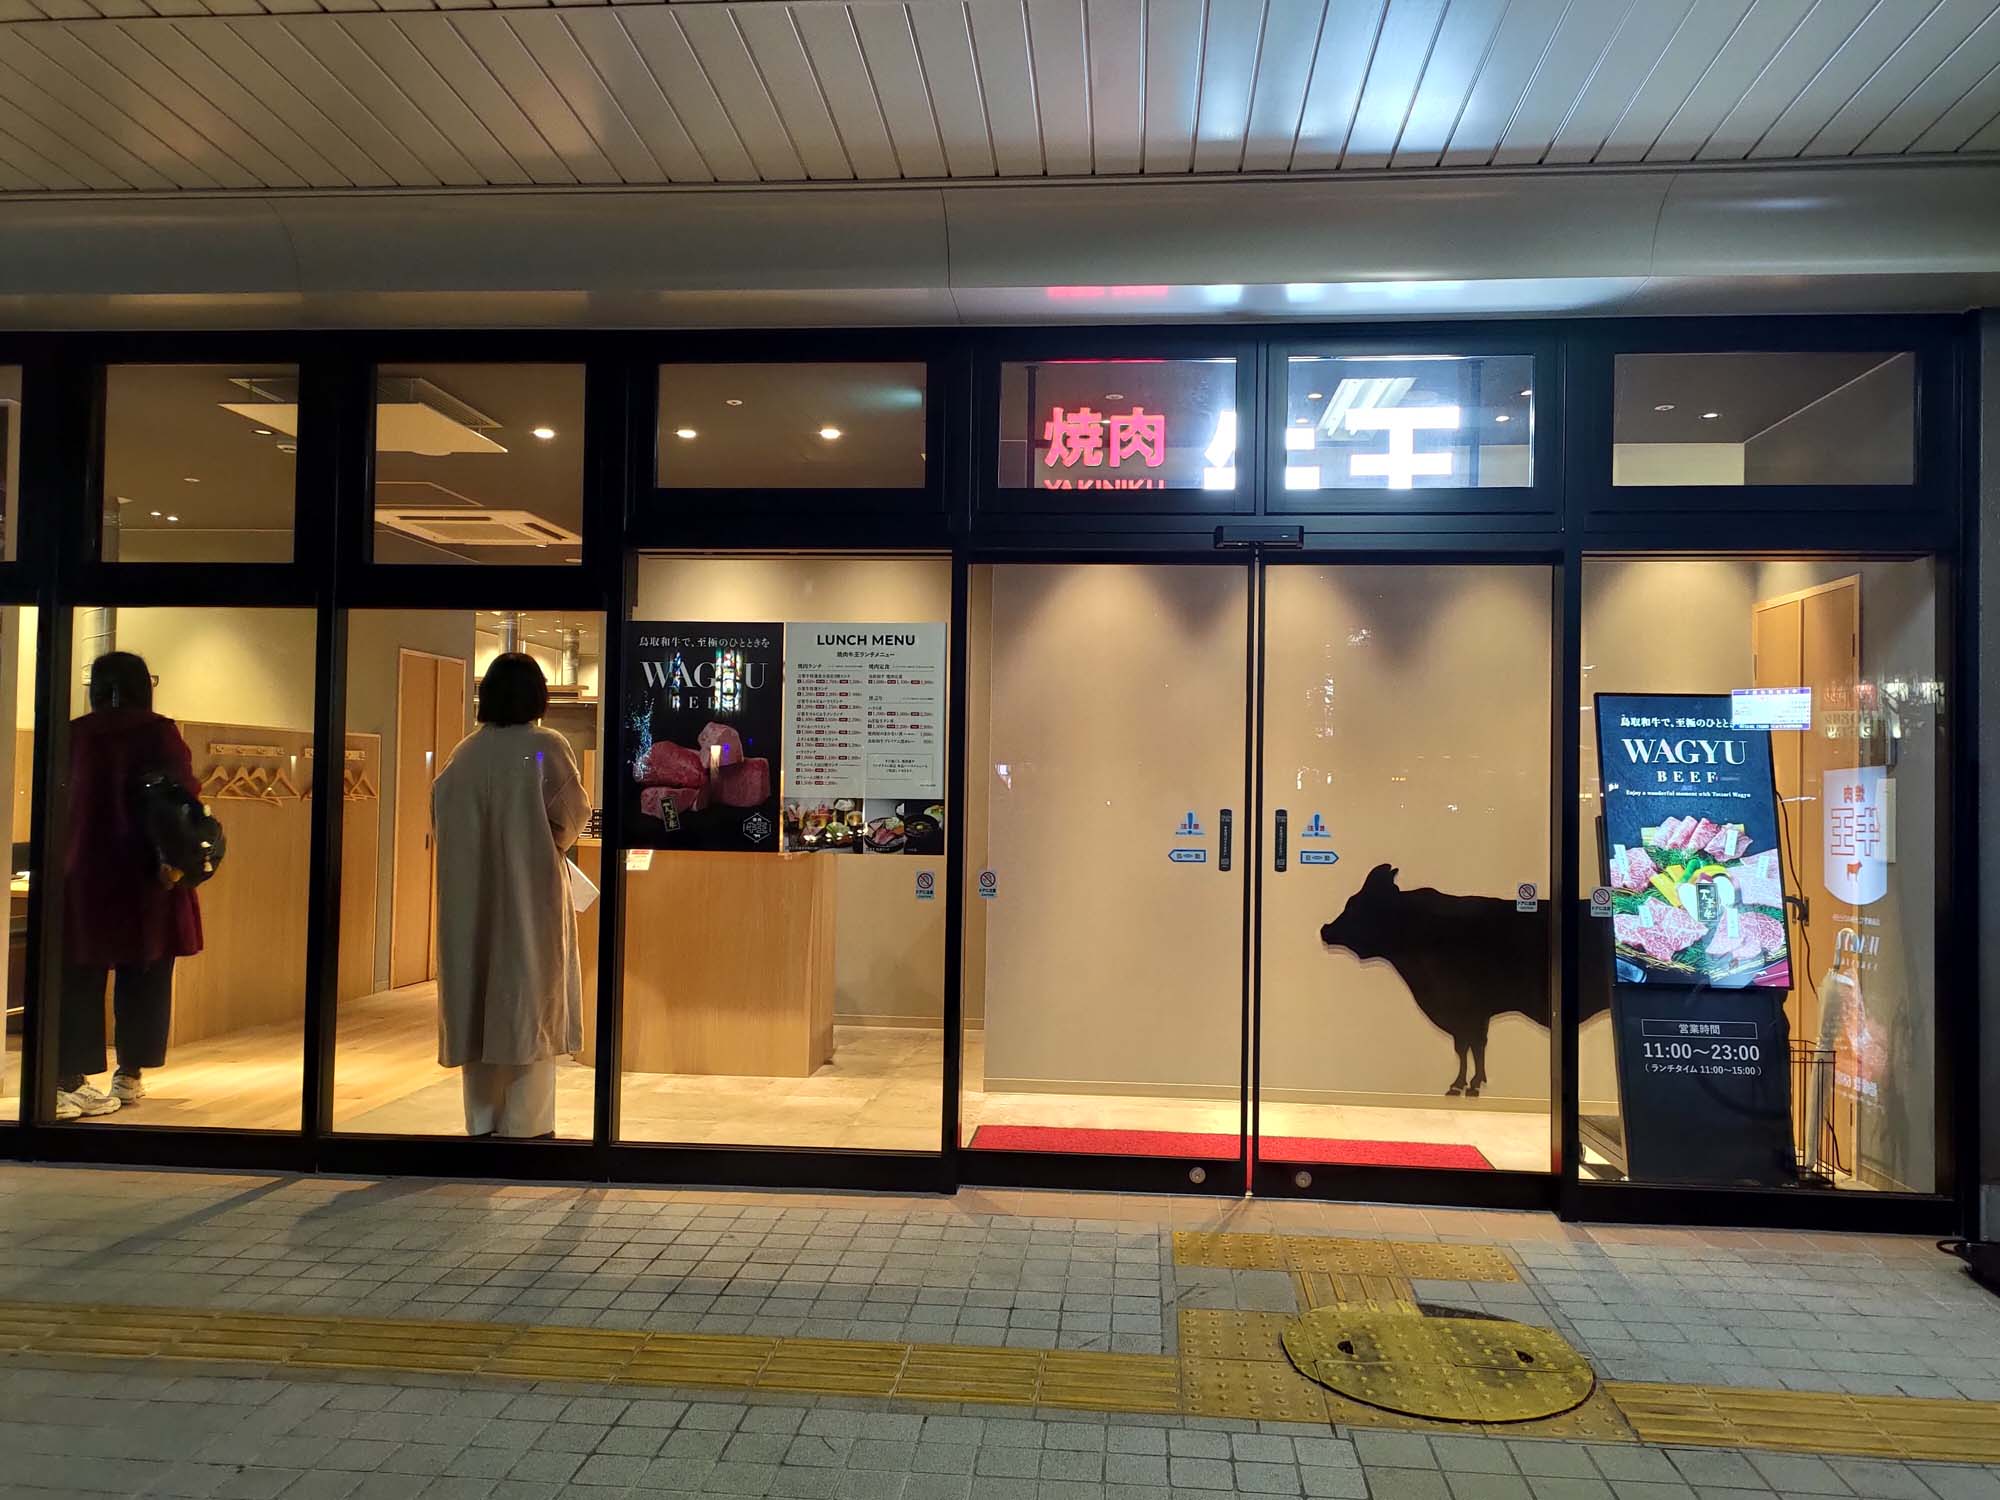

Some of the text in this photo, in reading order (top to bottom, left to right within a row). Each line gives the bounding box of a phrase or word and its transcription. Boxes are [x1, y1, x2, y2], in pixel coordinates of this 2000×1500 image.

[1043, 406, 1165, 468] 焼肉
[816, 634, 916, 646] LUNCH MENU
[1621, 738, 1748, 765] WAGYU
[1656, 770, 1718, 783] BEEF
[1678, 1023, 1721, 1035] 営業時間
